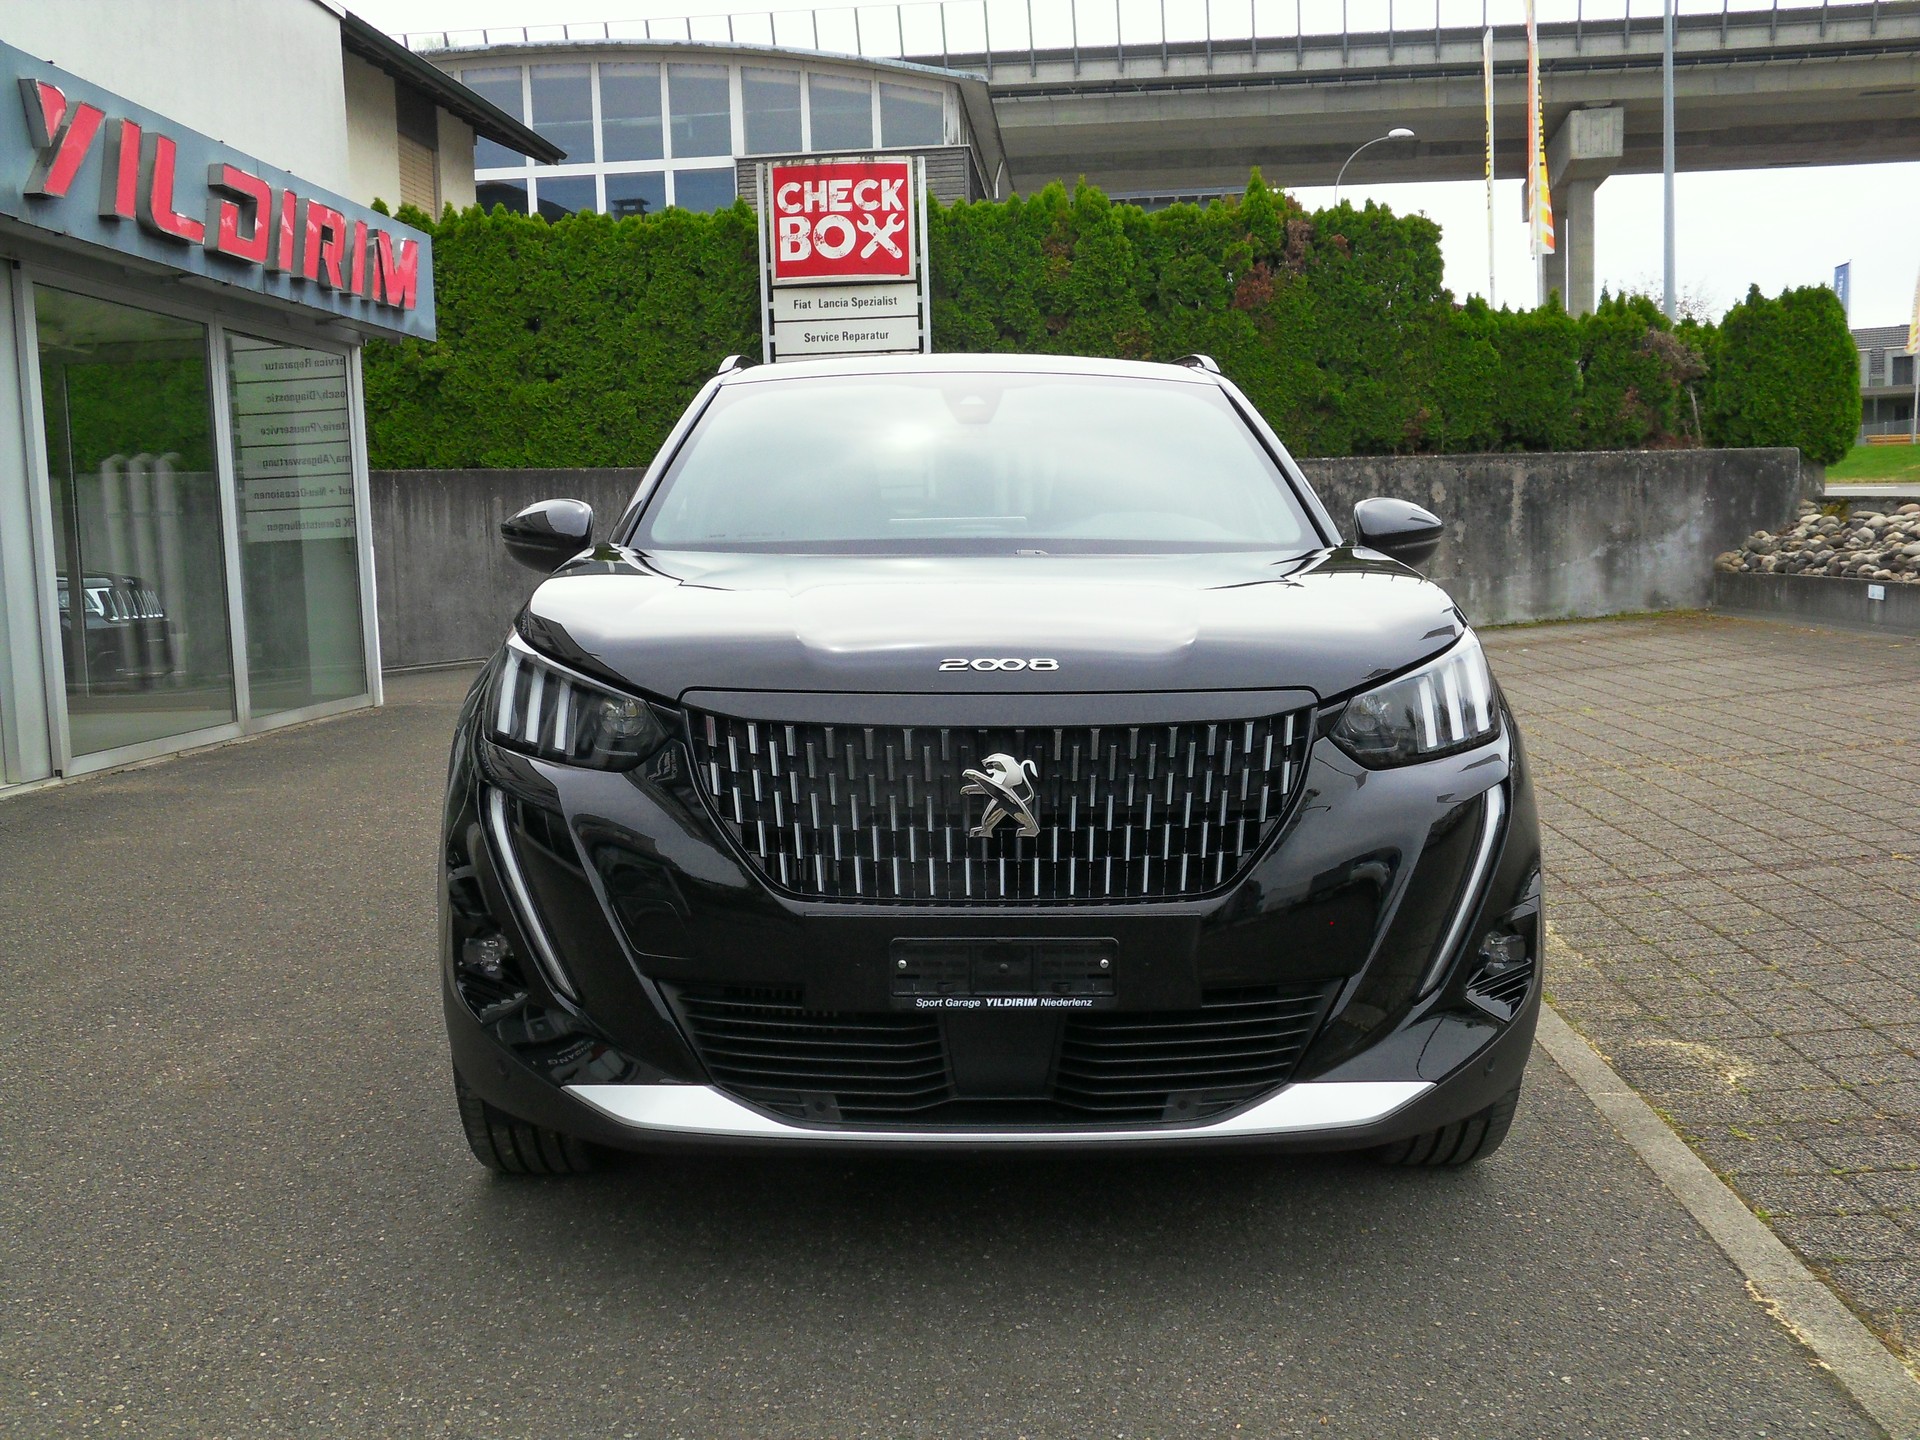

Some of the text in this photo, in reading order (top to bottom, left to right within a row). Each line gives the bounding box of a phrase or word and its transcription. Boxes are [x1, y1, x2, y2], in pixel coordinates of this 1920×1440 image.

[19, 78, 419, 311] YILDIRIM
[777, 178, 905, 214] CHECK
[793, 296, 898, 309] Fiat Lancia Spezialist
[804, 330, 890, 343] Service Reparatur
[939, 658, 1060, 672] 2008
[916, 998, 1093, 1008] Sport Garage YILDIRIM Niederlenz
